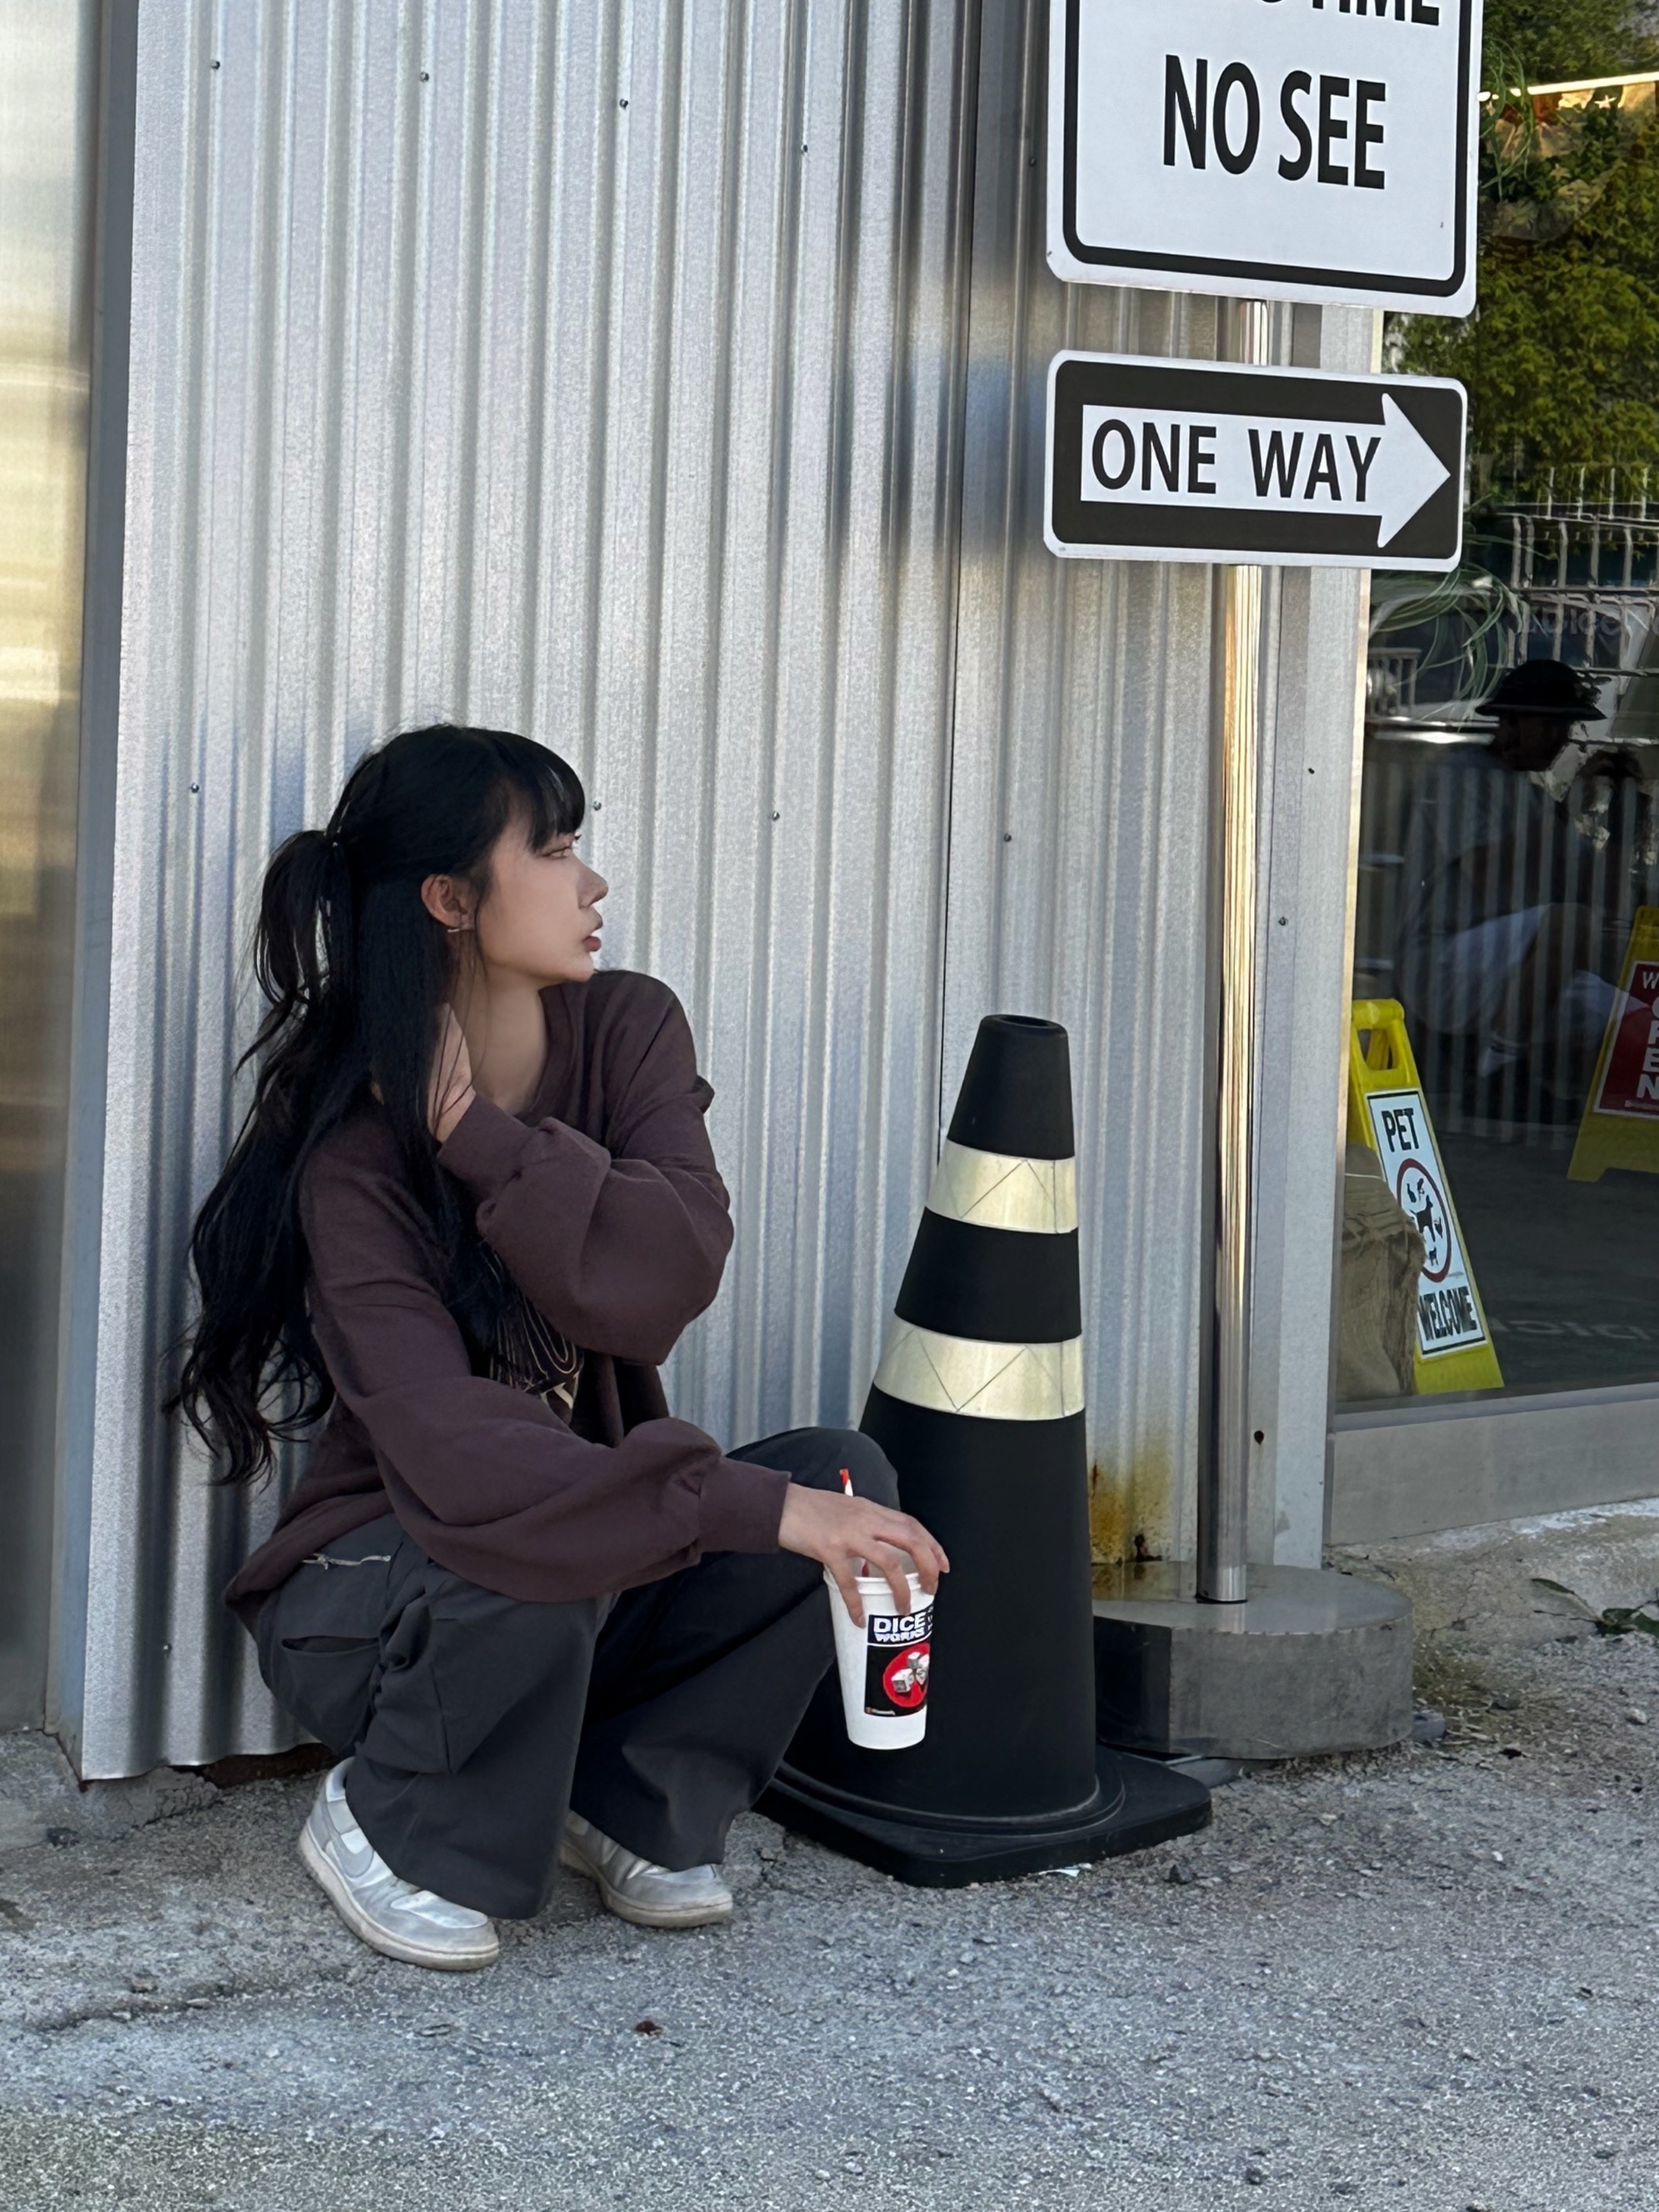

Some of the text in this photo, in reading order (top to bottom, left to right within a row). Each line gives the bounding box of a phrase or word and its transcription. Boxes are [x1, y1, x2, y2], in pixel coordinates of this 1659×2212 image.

[1163, 54, 1386, 189] NO SEE
[1092, 418, 1382, 502] ONE WAY
[1381, 1108, 1419, 1153] PET
[873, 1612, 927, 1633] DICE
